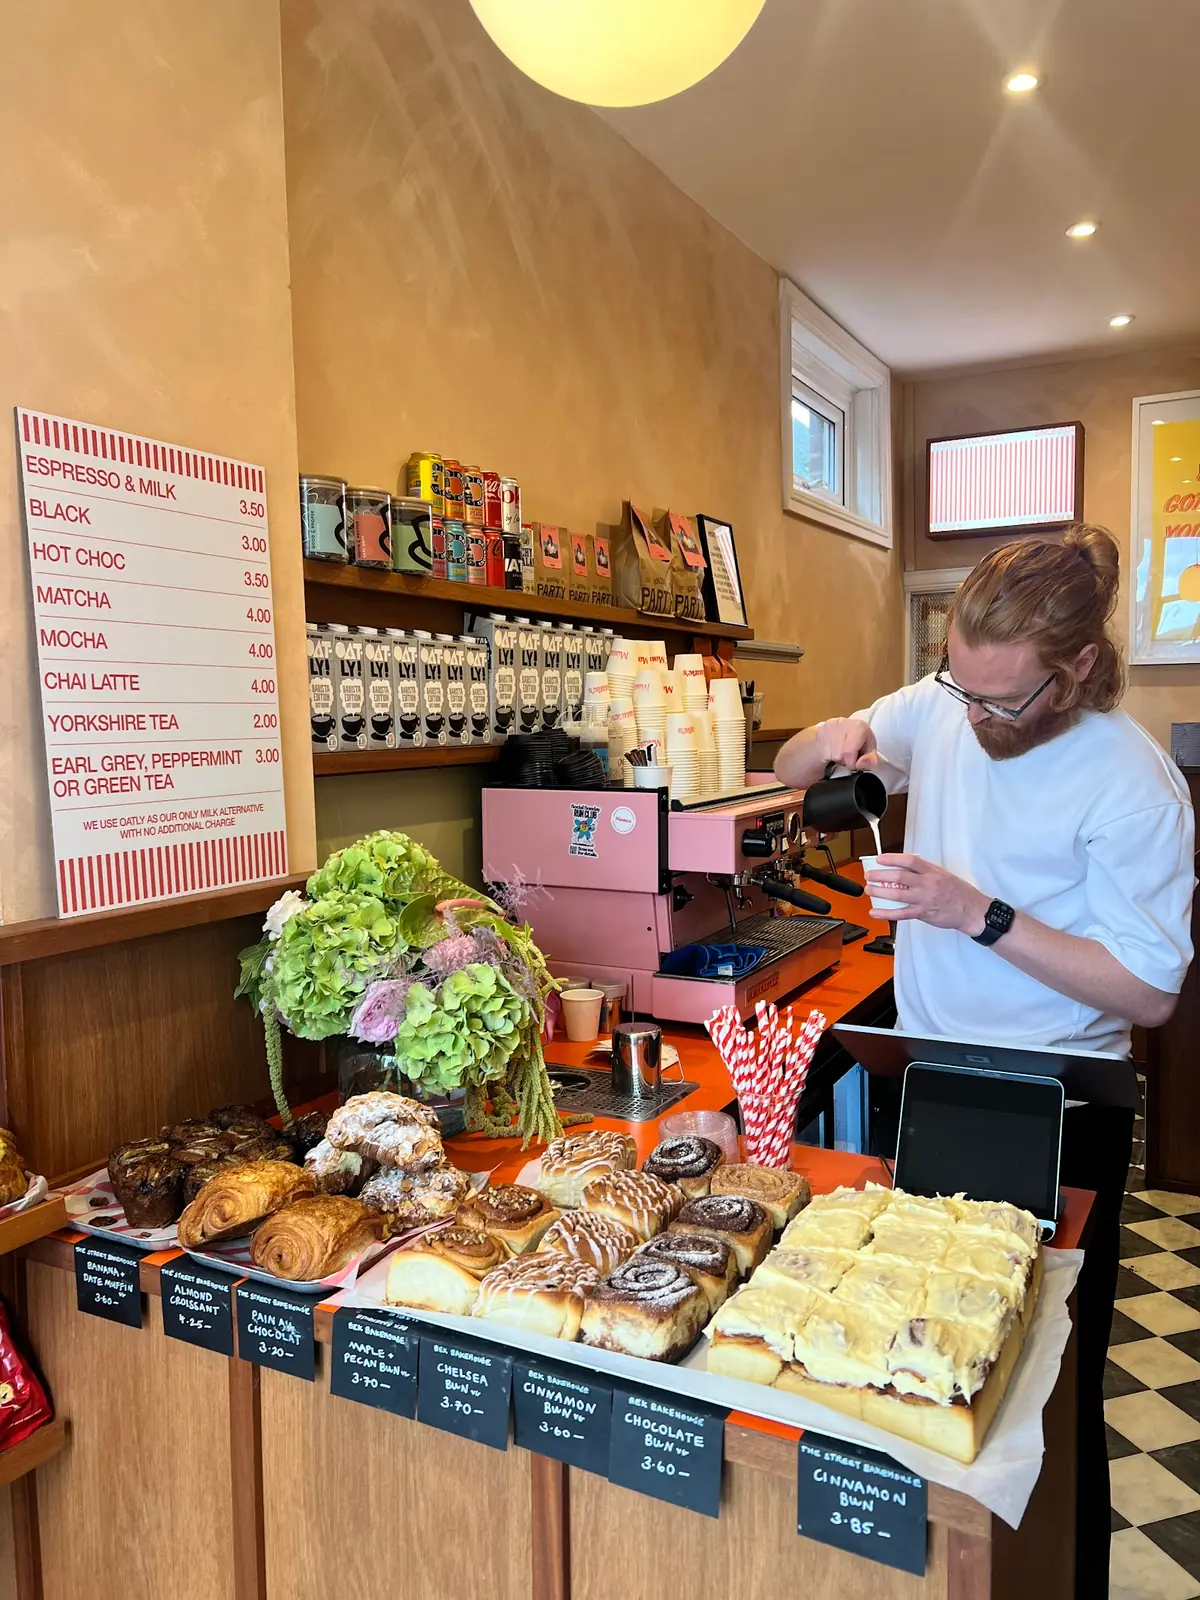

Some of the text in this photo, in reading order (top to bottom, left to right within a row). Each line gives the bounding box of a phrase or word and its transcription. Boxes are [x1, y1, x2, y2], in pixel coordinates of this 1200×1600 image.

[25, 455, 264, 518] ESPRESSO & MILK 3.50
[29, 498, 267, 553] BLACK 3.00
[32, 542, 269, 588] HOT CHOC 3.50
[537, 583, 566, 599] PARTY
[36, 585, 271, 624] MATCHA 4.00
[40, 628, 273, 659] MOCHA 4.00
[499, 648, 513, 665] LY!
[522, 650, 537, 666] LY!
[545, 652, 559, 668] LY!
[567, 653, 580, 668] LY!
[589, 655, 601, 669] LY!
[310, 658, 330, 676] LY!
[340, 660, 361, 676] LY!
[370, 661, 388, 678] LY!
[398, 662, 416, 678] LY!
[425, 664, 441, 679] LY!
[448, 665, 462, 680] LY!
[471, 667, 485, 681] LY!
[44, 672, 275, 694] CHAI LATTE 4.00
[48, 713, 277, 732] YORKSHIRE TEA 2.00
[52, 748, 280, 775] EARL GREY, PEPPERMINT 3.00
[53, 773, 175, 798] OR GREEN TEA
[83, 803, 264, 831] WE USE OATLY AS OUR ONLY MILK ALTERNATIVE
[574, 809, 597, 819] RUN CLUB
[120, 817, 236, 839] WITH NO ADDITIONAL CHARGE
[87, 1249, 107, 1259] STREET
[86, 1261, 120, 1277] BANANA
[161, 1268, 174, 1276] THE
[174, 1272, 195, 1283] STREET
[83, 1273, 134, 1292] DATE MUFFIN
[174, 1284, 212, 1302] ALMOND
[237, 1290, 249, 1298] THE
[250, 1293, 271, 1304] STREET
[170, 1295, 220, 1316] CROISSANT
[252, 1310, 275, 1325] PAIN
[247, 1323, 301, 1345] CHOCOLAT
[349, 1341, 385, 1358] MAPLE
[450, 1349, 492, 1366] BAKEHOUSE
[344, 1352, 377, 1368] PECAN
[379, 1362, 400, 1375] BUN
[437, 1363, 488, 1387] CHELSEA
[445, 1379, 469, 1394] BUN
[523, 1382, 596, 1414] CINNAMON
[544, 1402, 572, 1419] BUN
[628, 1397, 704, 1427] BEK BAKEHOUSE
[625, 1413, 704, 1448] CHOCOLATE
[645, 1433, 674, 1452] BUN
[801, 1445, 922, 1488] THE STREET BAKEHOUSE
[813, 1468, 906, 1506] CINNAMON
[840, 1492, 874, 1512] BUN
